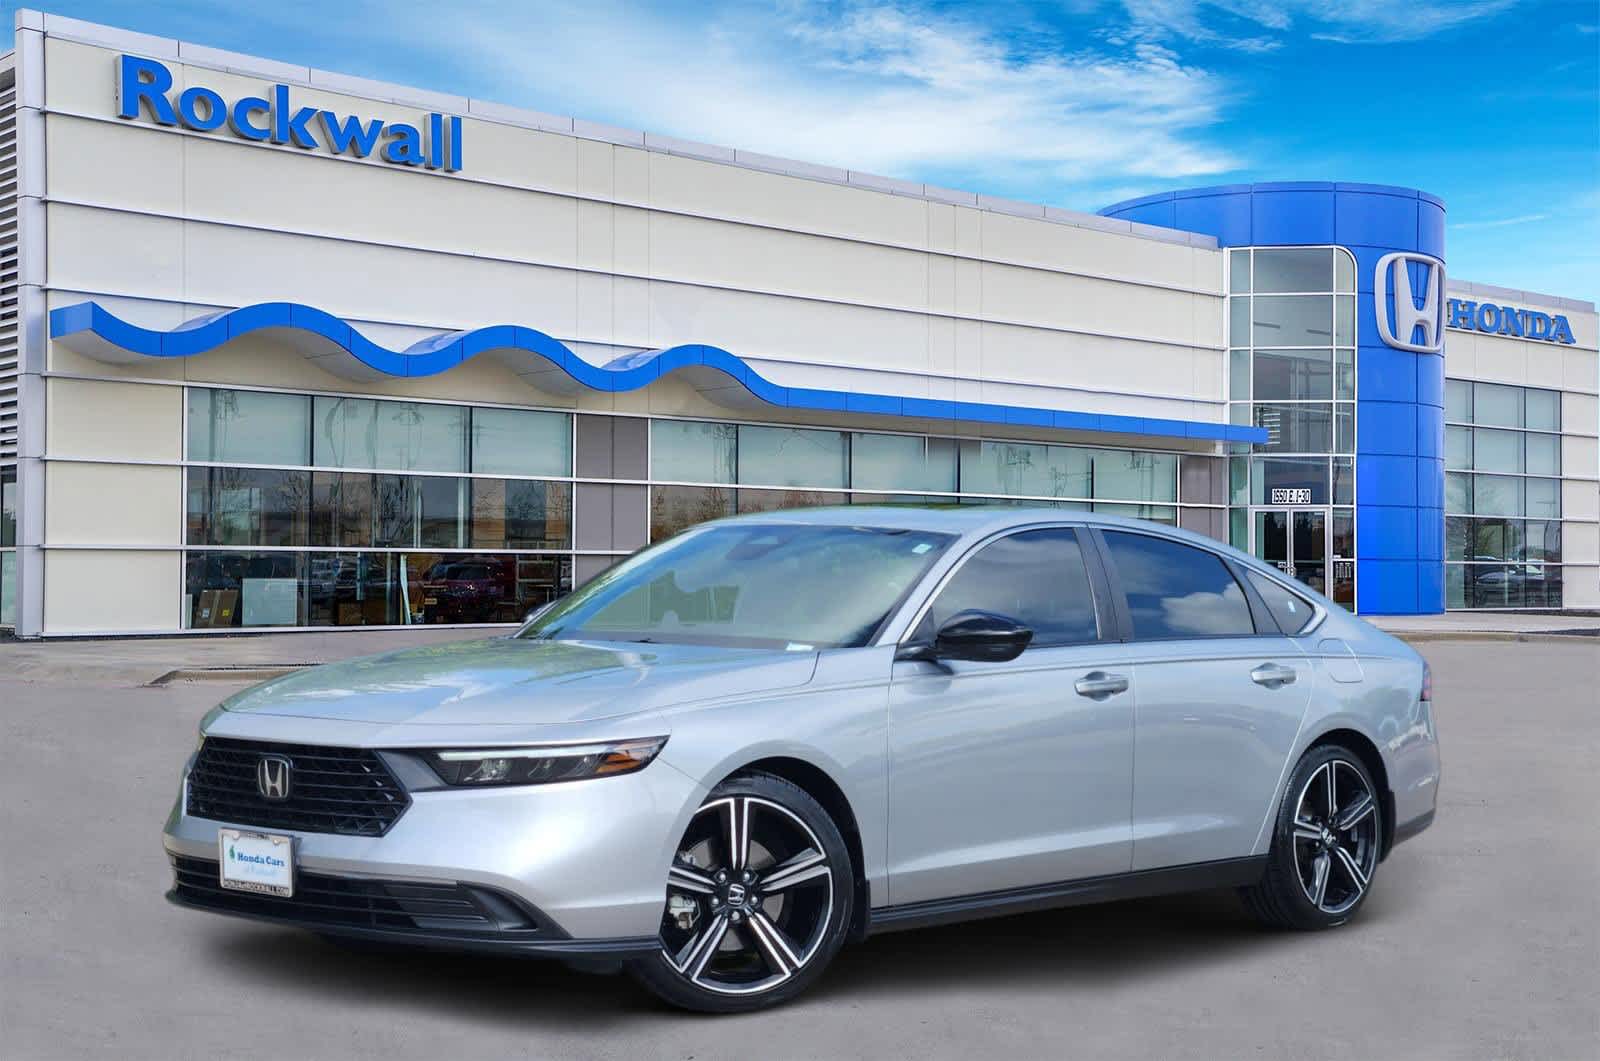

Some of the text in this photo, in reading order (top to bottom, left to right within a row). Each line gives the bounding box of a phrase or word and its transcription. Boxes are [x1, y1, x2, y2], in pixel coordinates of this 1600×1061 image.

[116, 54, 463, 172] Rockwall
[1447, 297, 1576, 344] HONDA
[1274, 489, 1288, 503] 1550
[237, 852, 285, 867] Honda Cars
